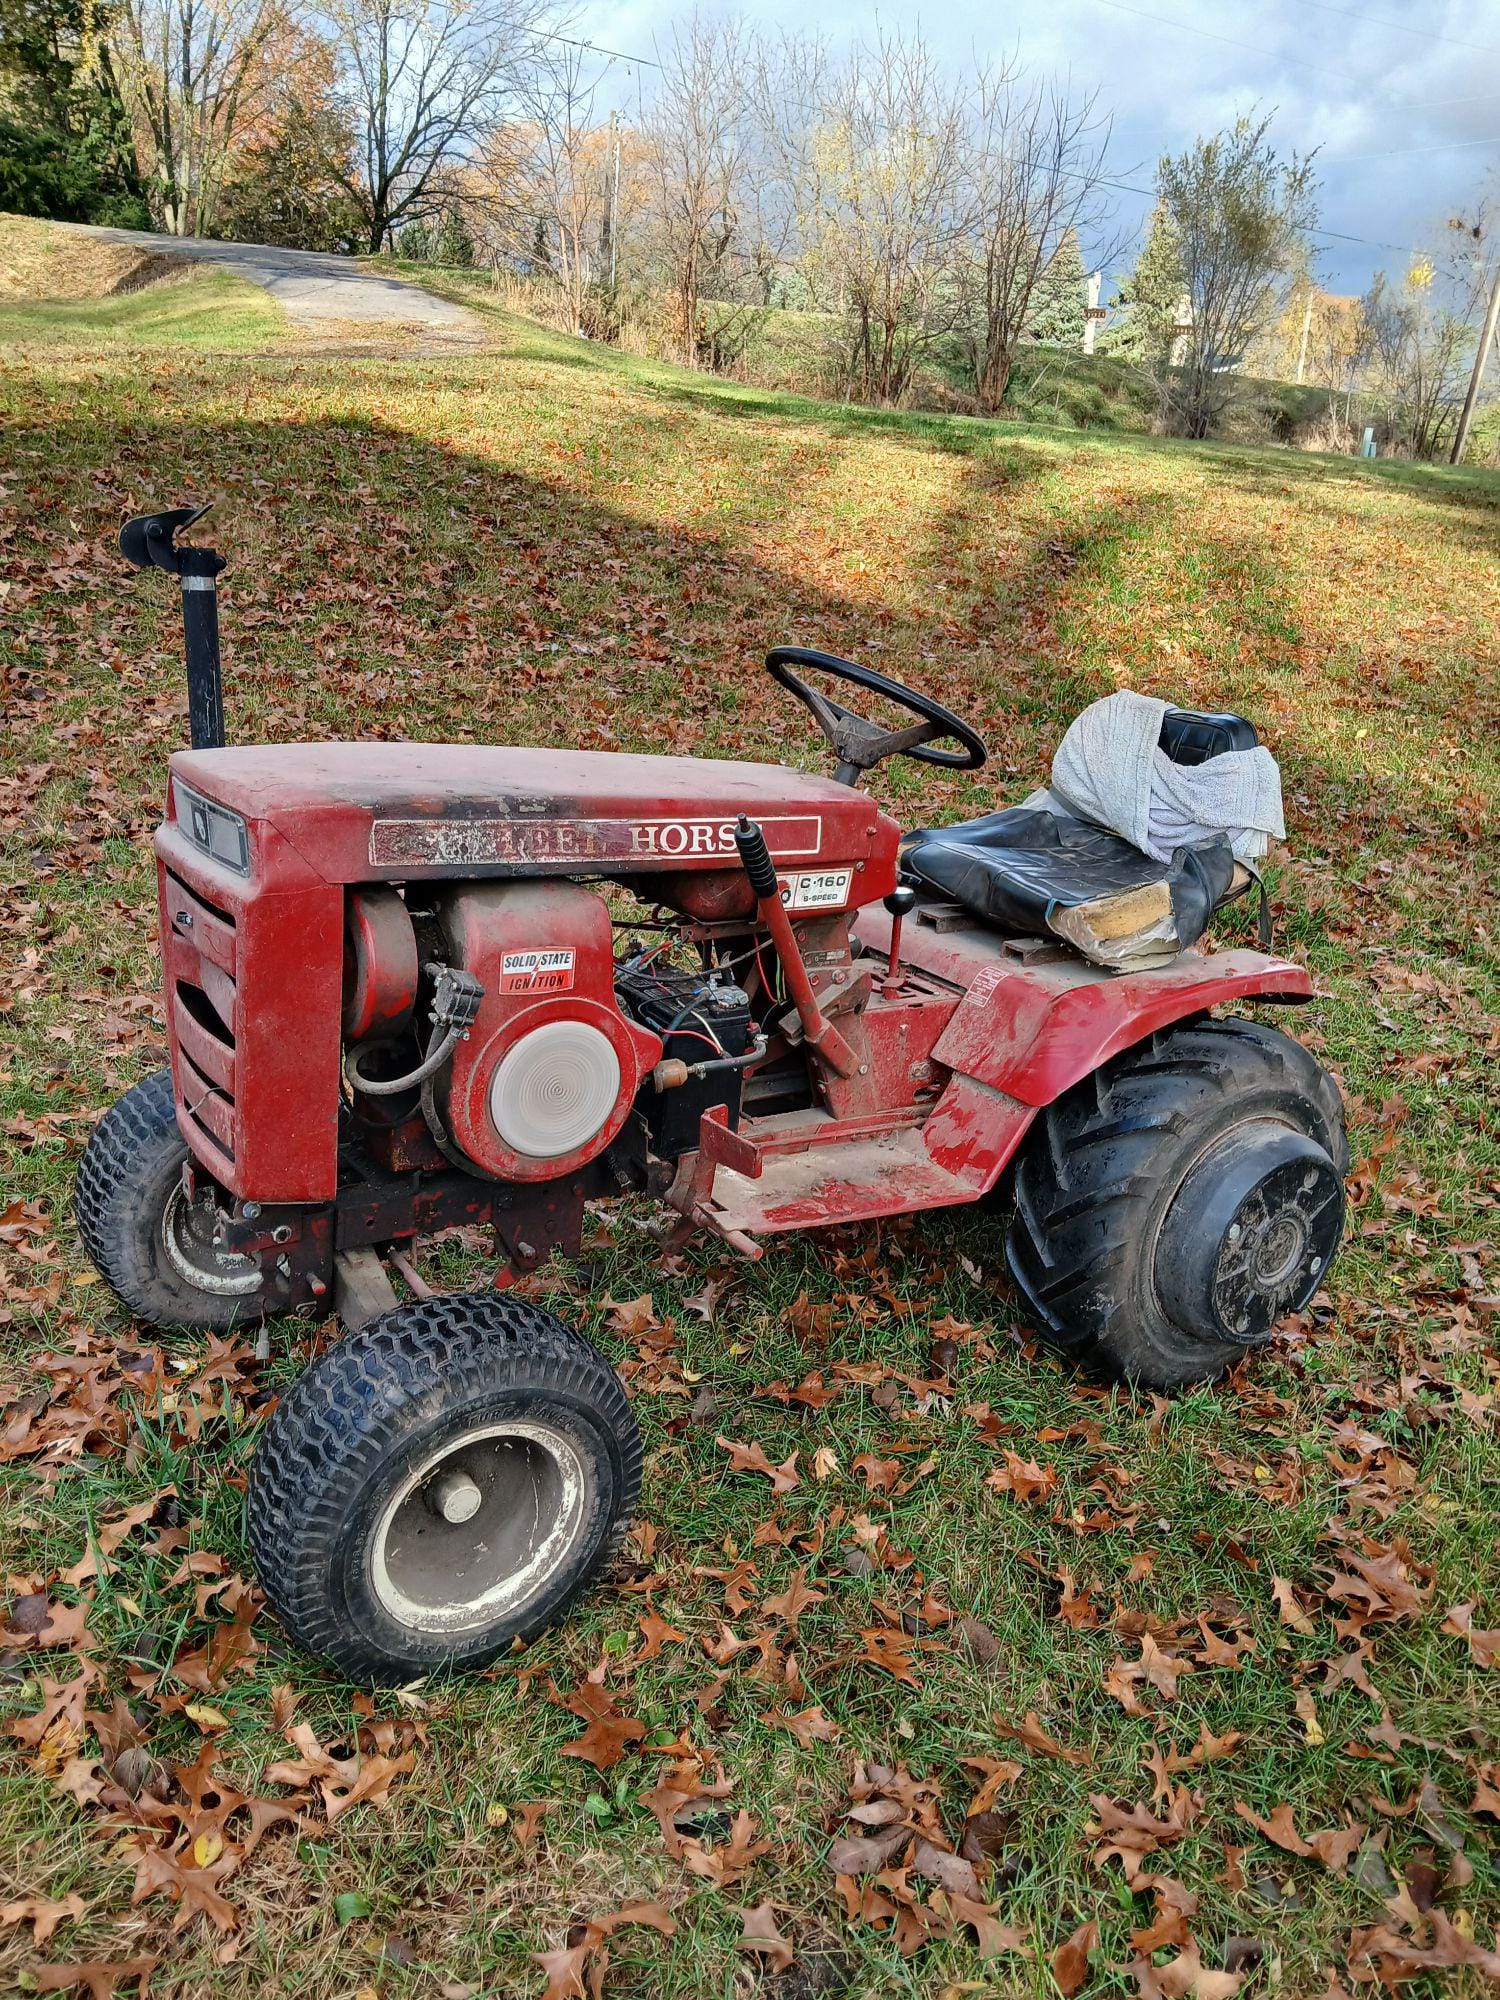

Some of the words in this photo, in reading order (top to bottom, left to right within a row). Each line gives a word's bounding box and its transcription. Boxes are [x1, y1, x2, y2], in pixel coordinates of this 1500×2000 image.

[628, 824, 762, 854] HORS
[504, 954, 537, 968] SOLID
[540, 952, 571, 966] STATE
[509, 974, 565, 990] IGNITION
